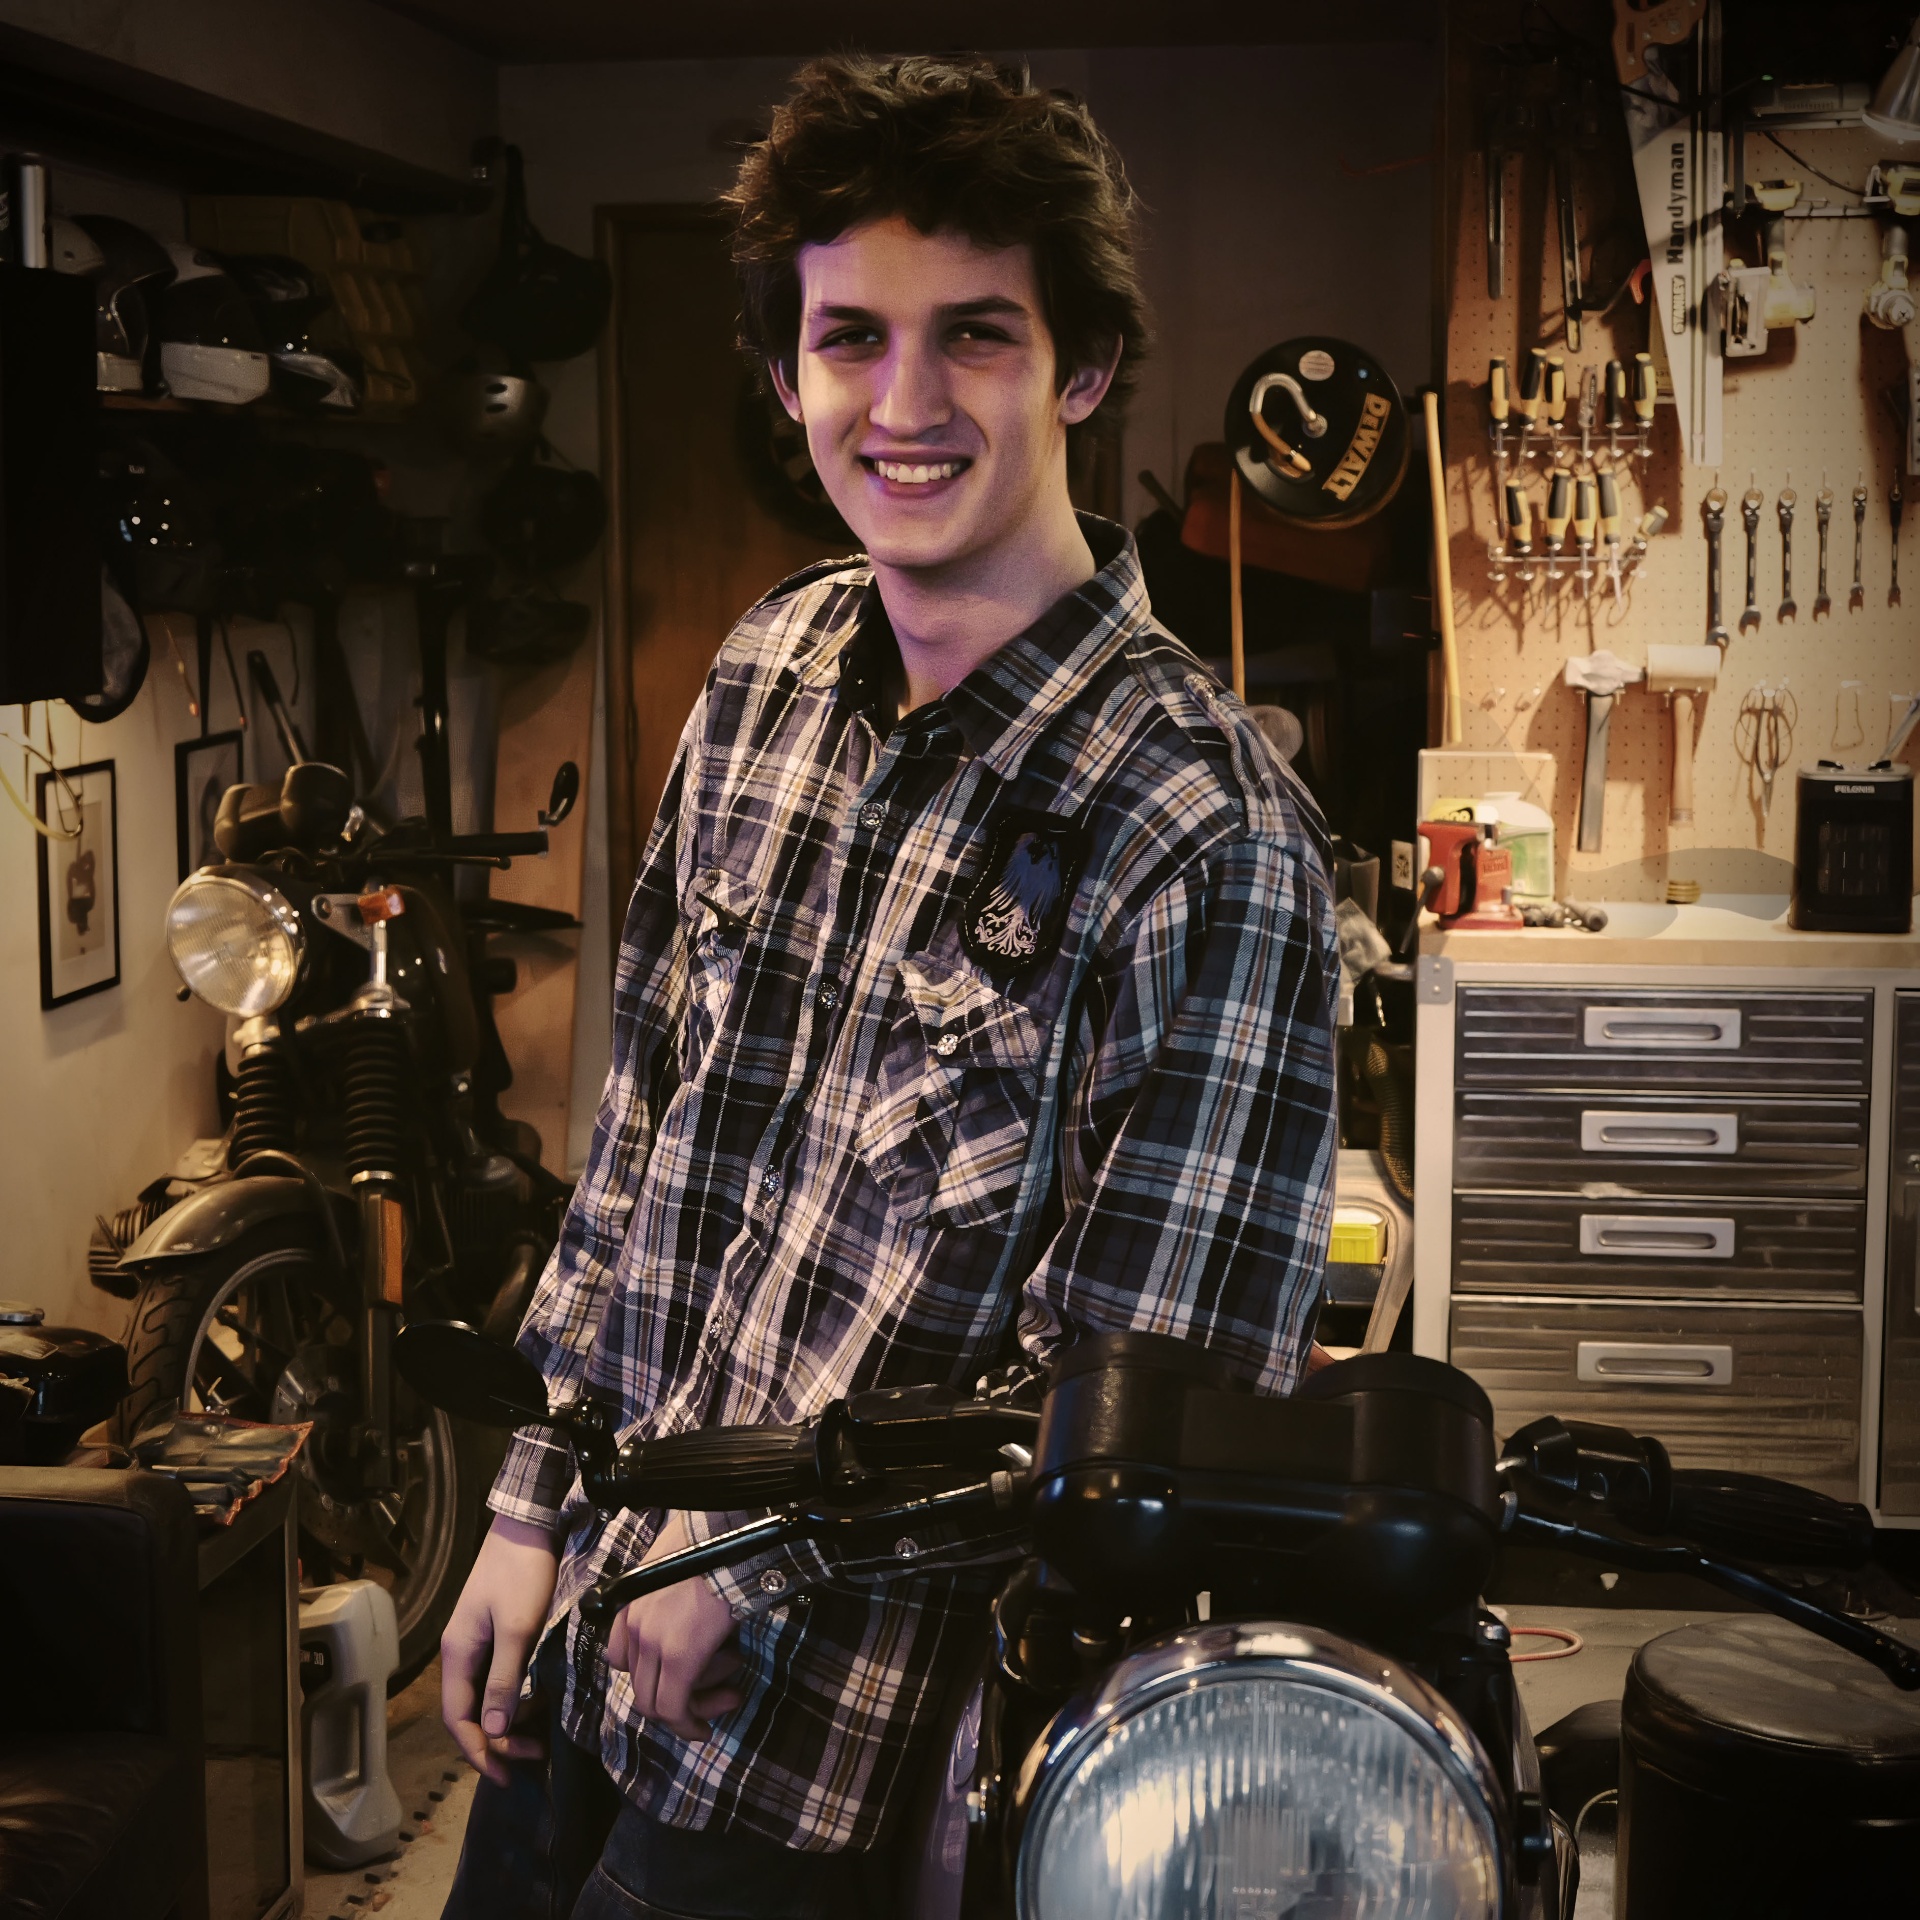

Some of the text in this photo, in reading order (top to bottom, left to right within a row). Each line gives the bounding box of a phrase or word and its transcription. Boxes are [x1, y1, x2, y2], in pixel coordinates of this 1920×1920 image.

[1667, 142, 1687, 335] STANLEY Handyman
[1322, 393, 1391, 501] DEWALT
